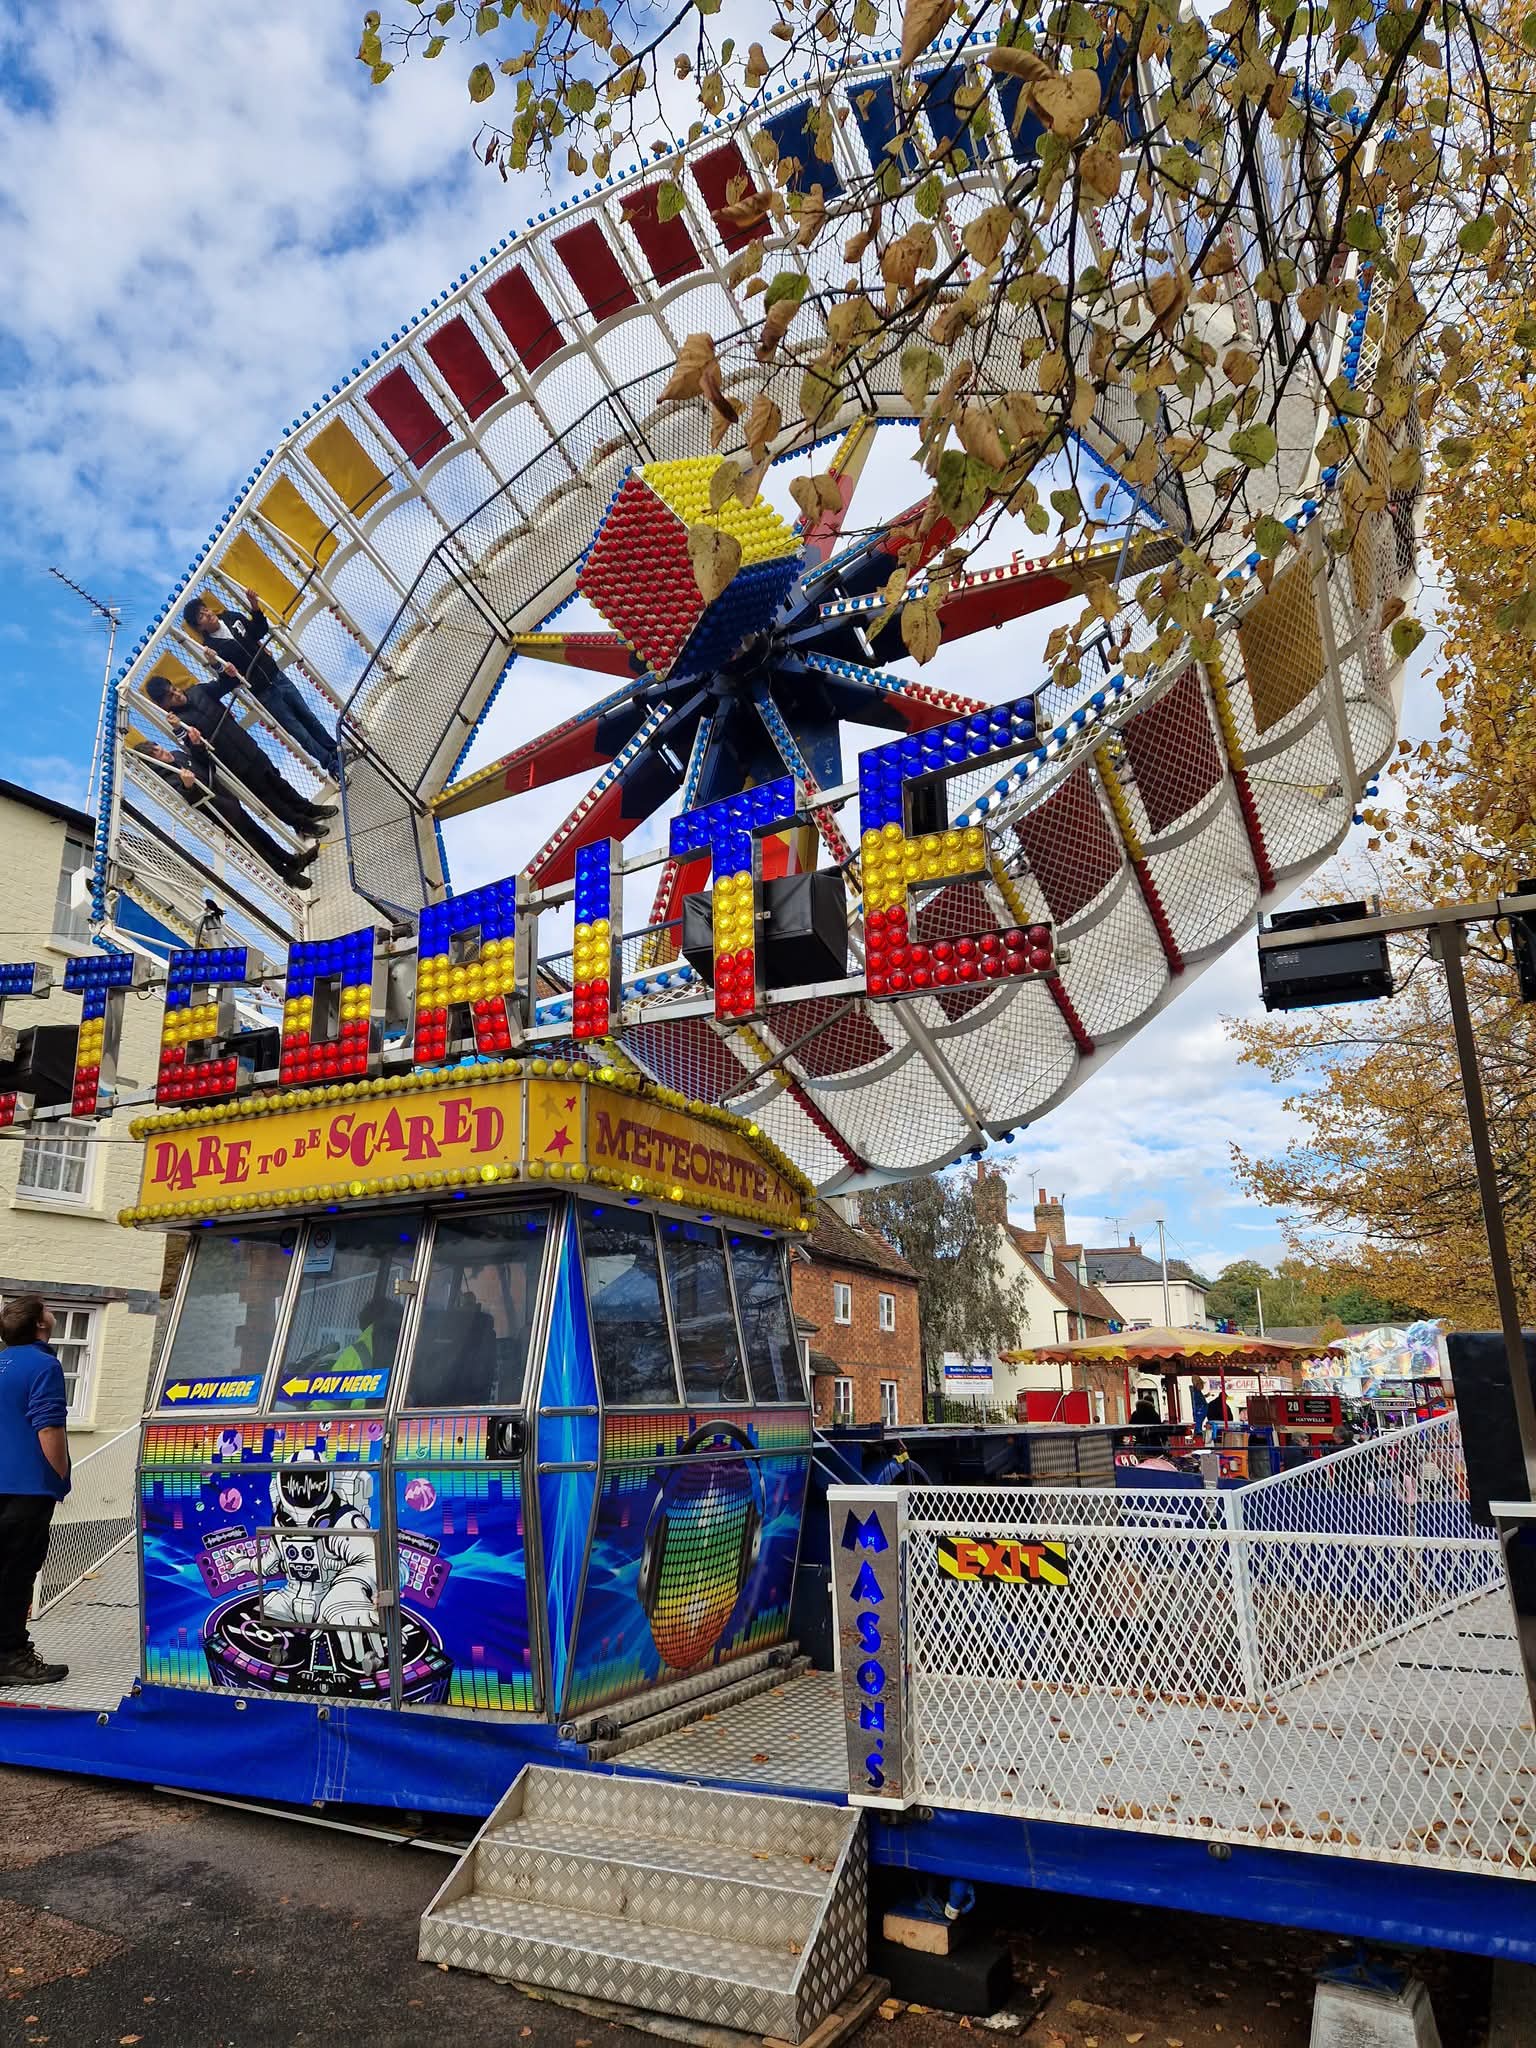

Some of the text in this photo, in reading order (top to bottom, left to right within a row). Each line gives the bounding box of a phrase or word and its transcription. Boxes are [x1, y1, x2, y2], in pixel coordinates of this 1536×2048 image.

[151, 1097, 505, 1191] DARE TO BE SCARED
[595, 1111, 768, 1202] METEORITE
[190, 1380, 256, 1399] PAY HERE
[309, 1374, 383, 1394] PAY HERE
[956, 1543, 1045, 1578] EXIT
